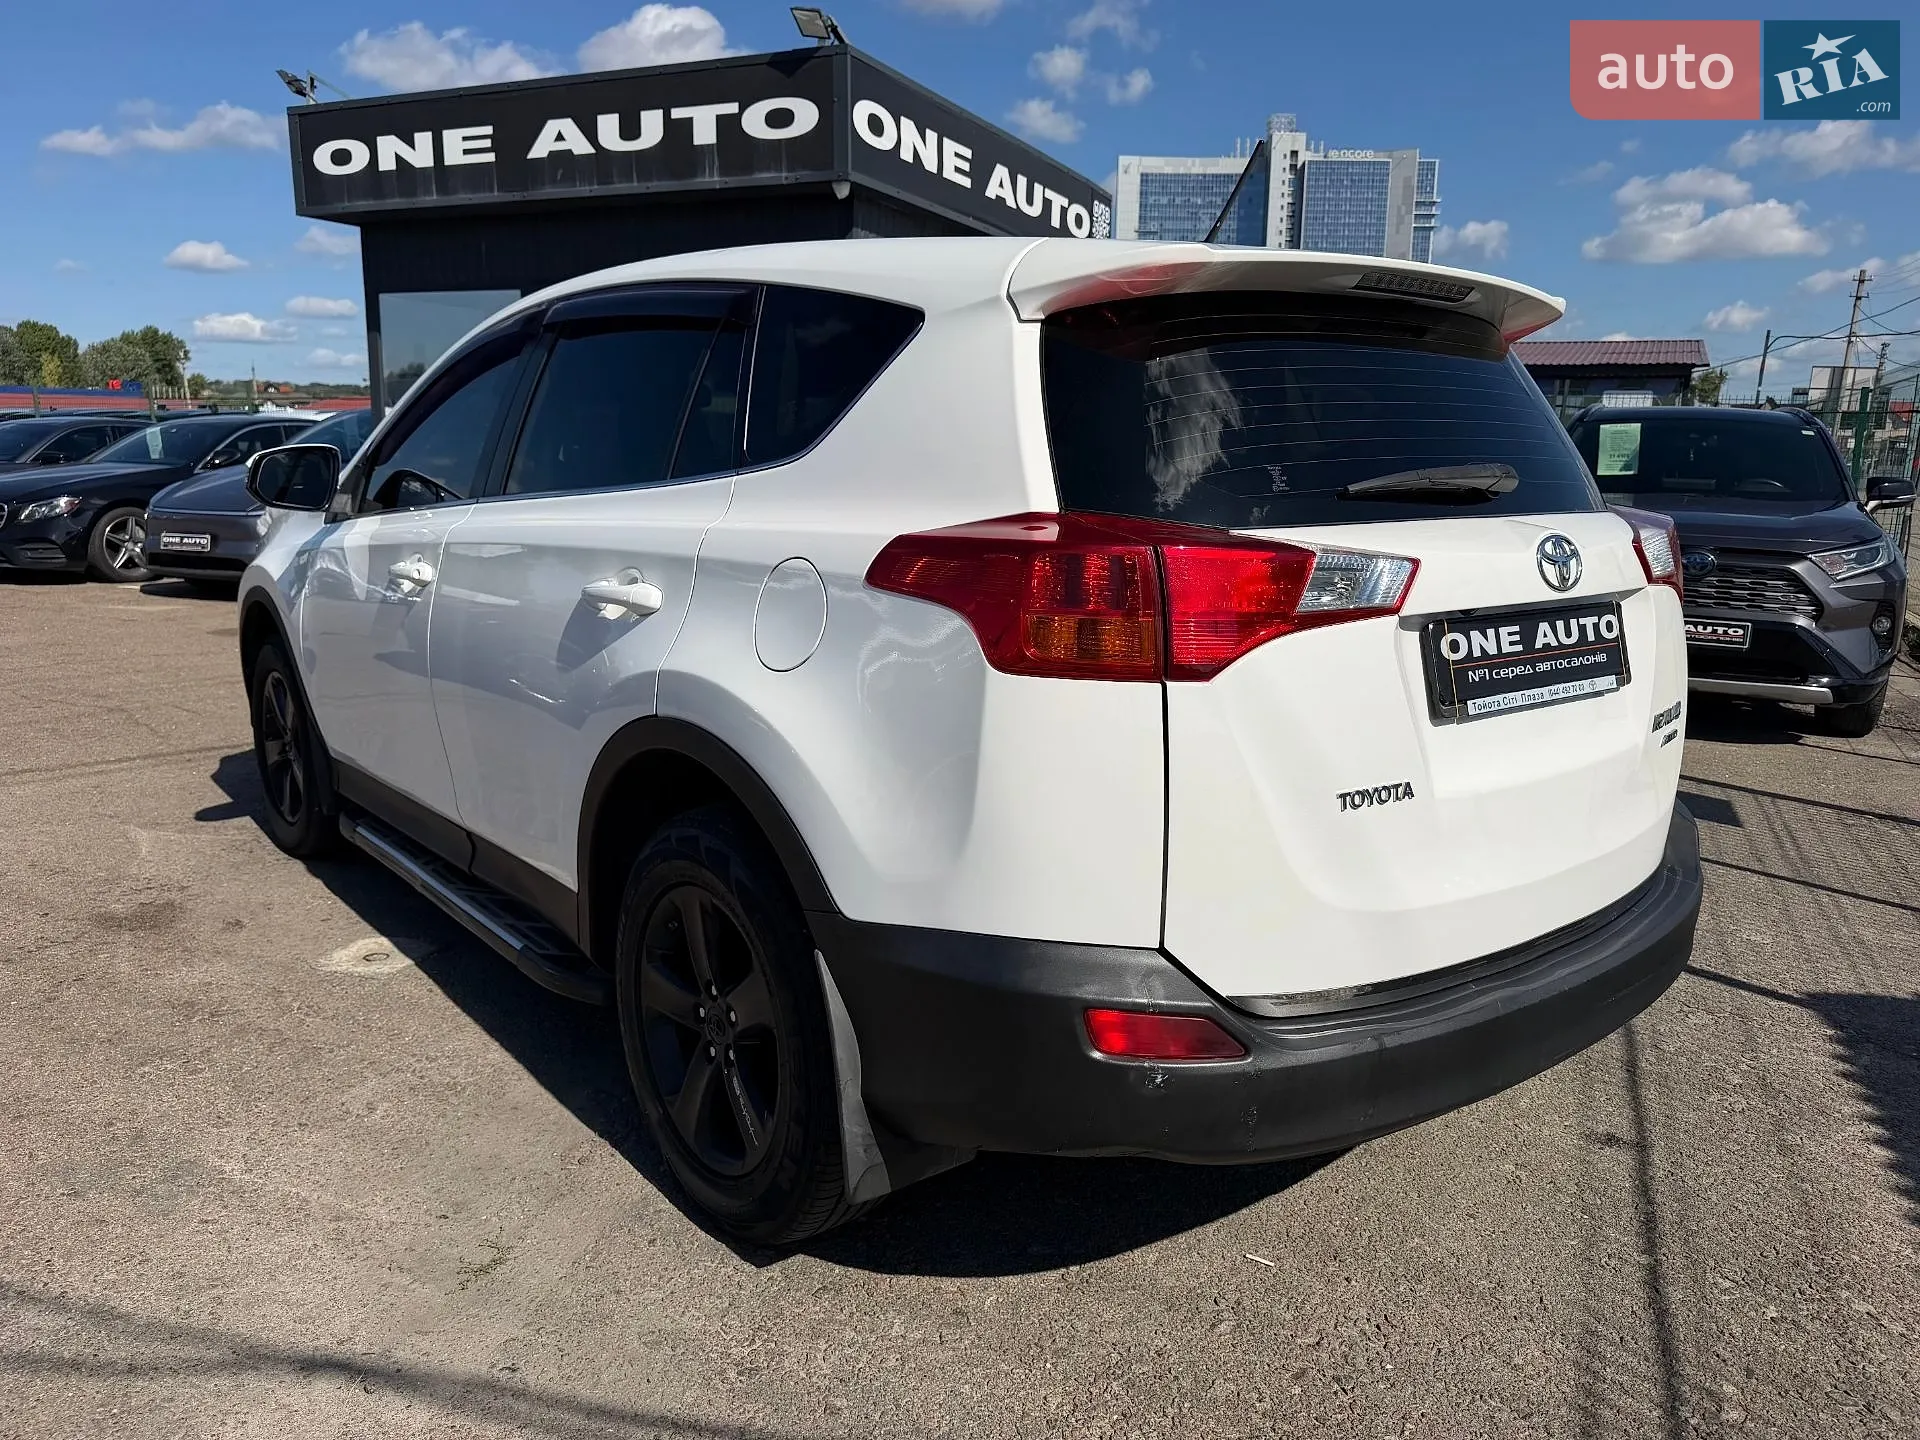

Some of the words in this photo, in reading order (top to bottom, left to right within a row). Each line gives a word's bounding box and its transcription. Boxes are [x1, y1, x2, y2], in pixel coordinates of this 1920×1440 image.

[312, 124, 497, 176] ONE
[525, 96, 820, 160] AUTO
[851, 98, 973, 188] ONE
[984, 162, 1091, 239] AUTO
[1440, 625, 1523, 661] ONE
[1534, 613, 1620, 649] AUTO
[1684, 624, 1744, 635] AUTO
[1492, 663, 1534, 679] серед
[1535, 652, 1608, 673] автосалонів
[1472, 699, 1501, 712] Тойота
[1520, 691, 1545, 704] Плаза
[1336, 781, 1415, 812] TOYOTA
